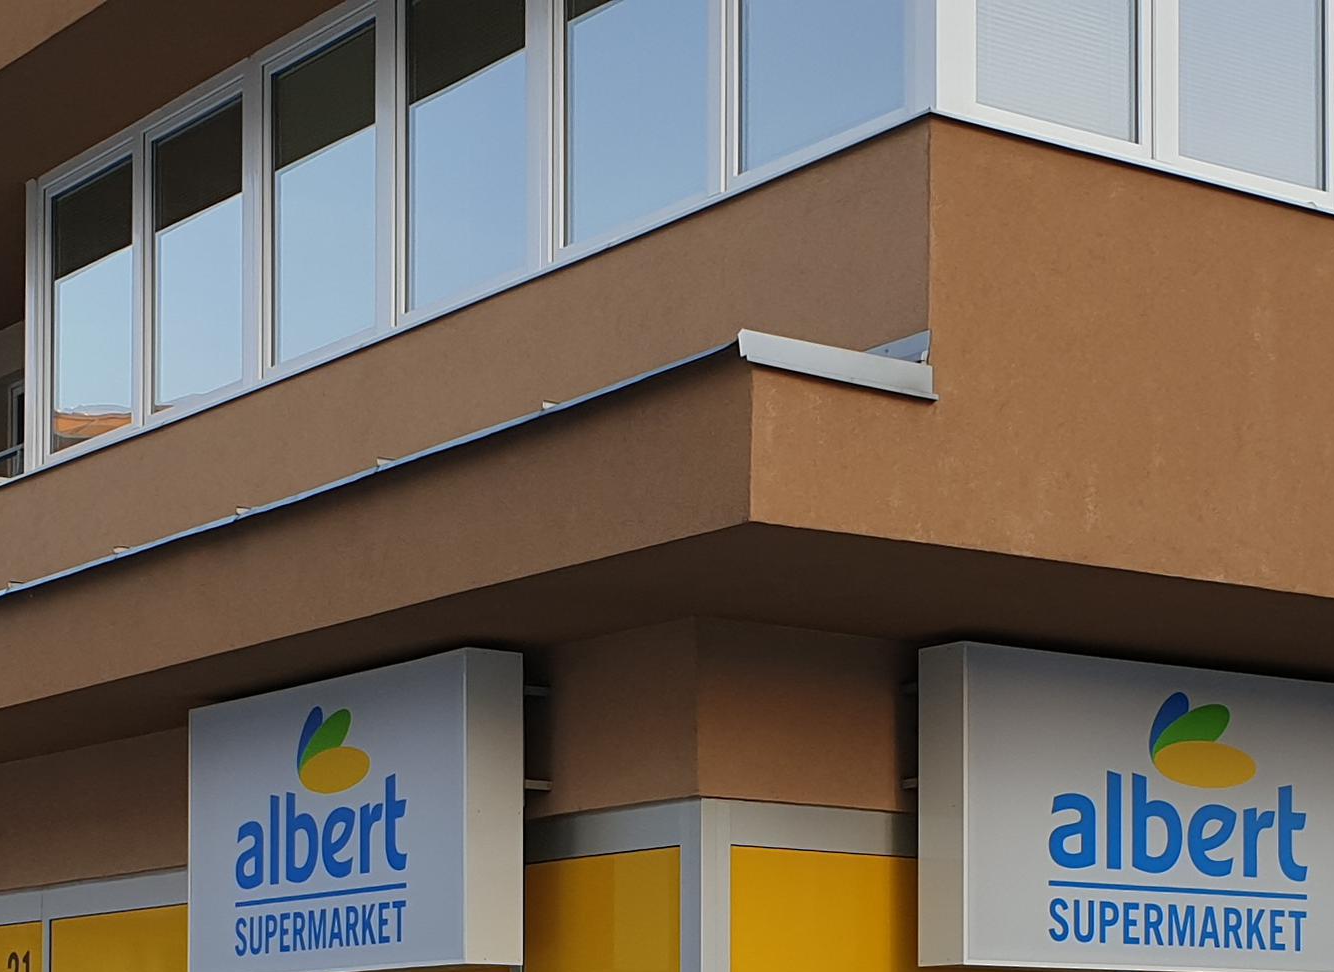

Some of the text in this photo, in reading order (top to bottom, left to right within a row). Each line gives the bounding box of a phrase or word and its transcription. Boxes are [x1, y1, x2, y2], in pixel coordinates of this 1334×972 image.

[235, 773, 408, 890] albert
[1048, 769, 1309, 883] albert
[234, 900, 408, 957] SUPERMARKET
[1048, 897, 1308, 952] SUPERMARKET
